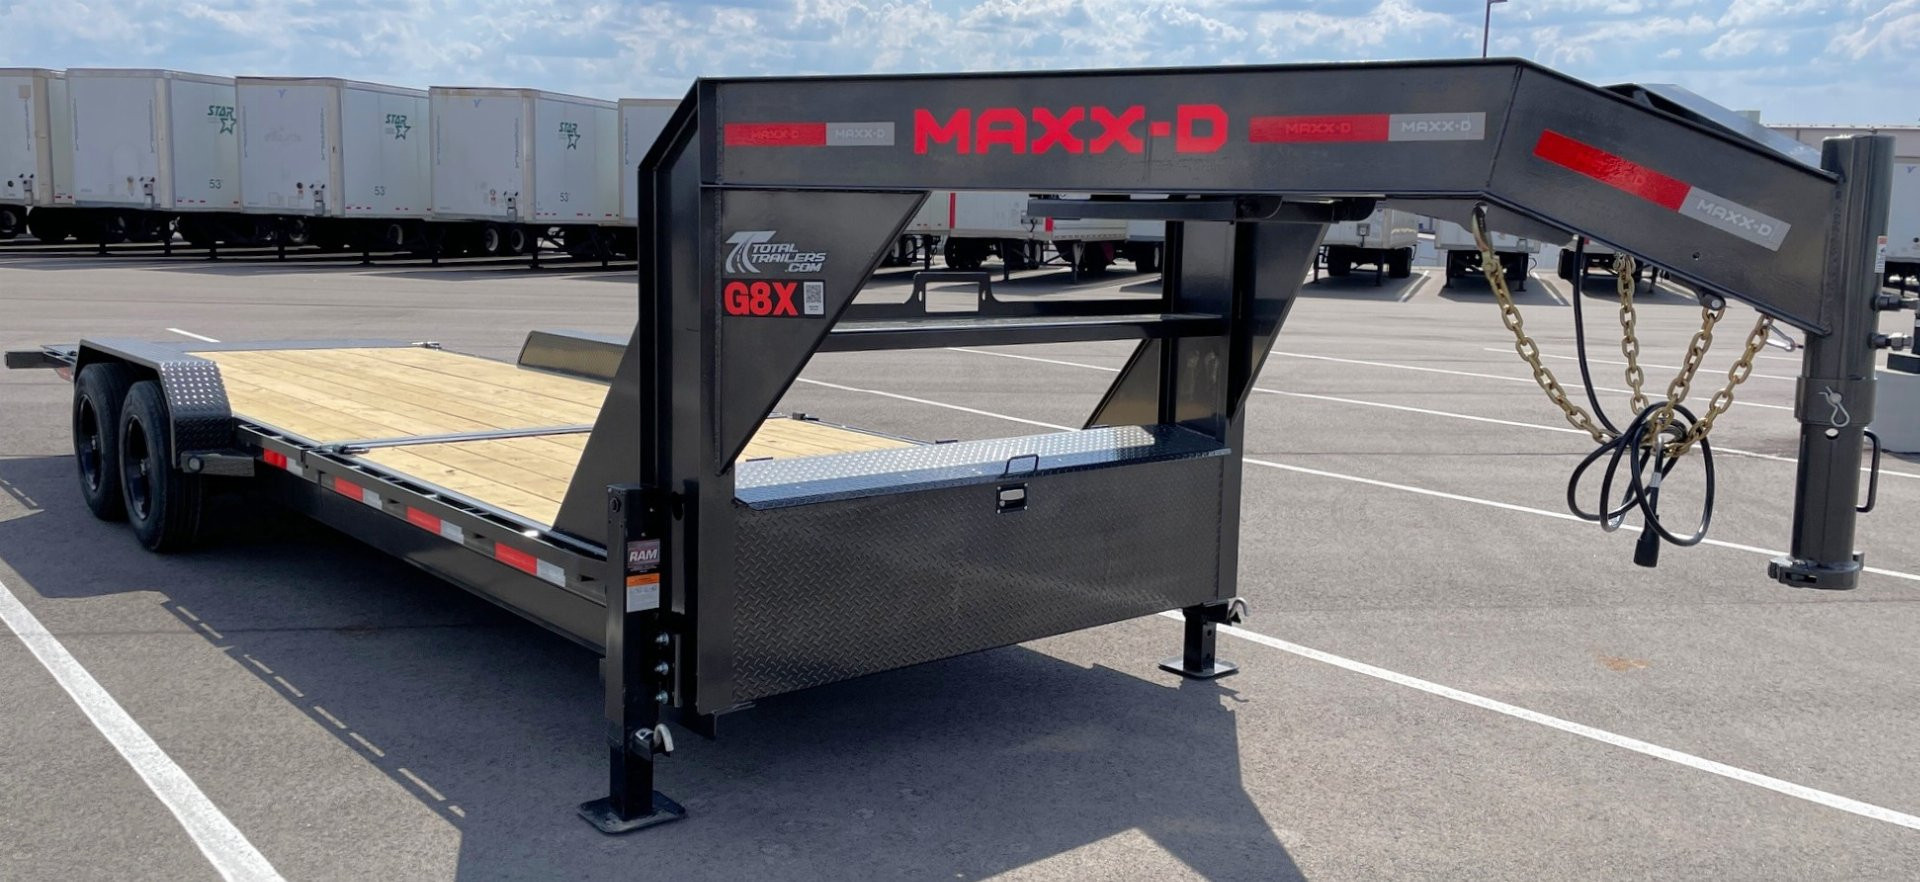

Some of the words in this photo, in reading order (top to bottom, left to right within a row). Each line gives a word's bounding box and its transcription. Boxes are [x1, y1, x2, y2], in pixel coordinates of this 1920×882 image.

[207, 105, 234, 117] STAR
[385, 114, 407, 125] STAR
[558, 121, 578, 133] STAR
[914, 104, 1228, 154] MAXX-D
[1401, 120, 1471, 133] MAXX-D
[834, 129, 885, 139] MAXX-D
[1696, 199, 1773, 237] MAXX-D
[753, 243, 798, 253] TOTAL
[751, 253, 826, 263] TRAILERS
[784, 263, 823, 272] .COM
[724, 282, 798, 316] G8X
[629, 549, 657, 562] RAM
